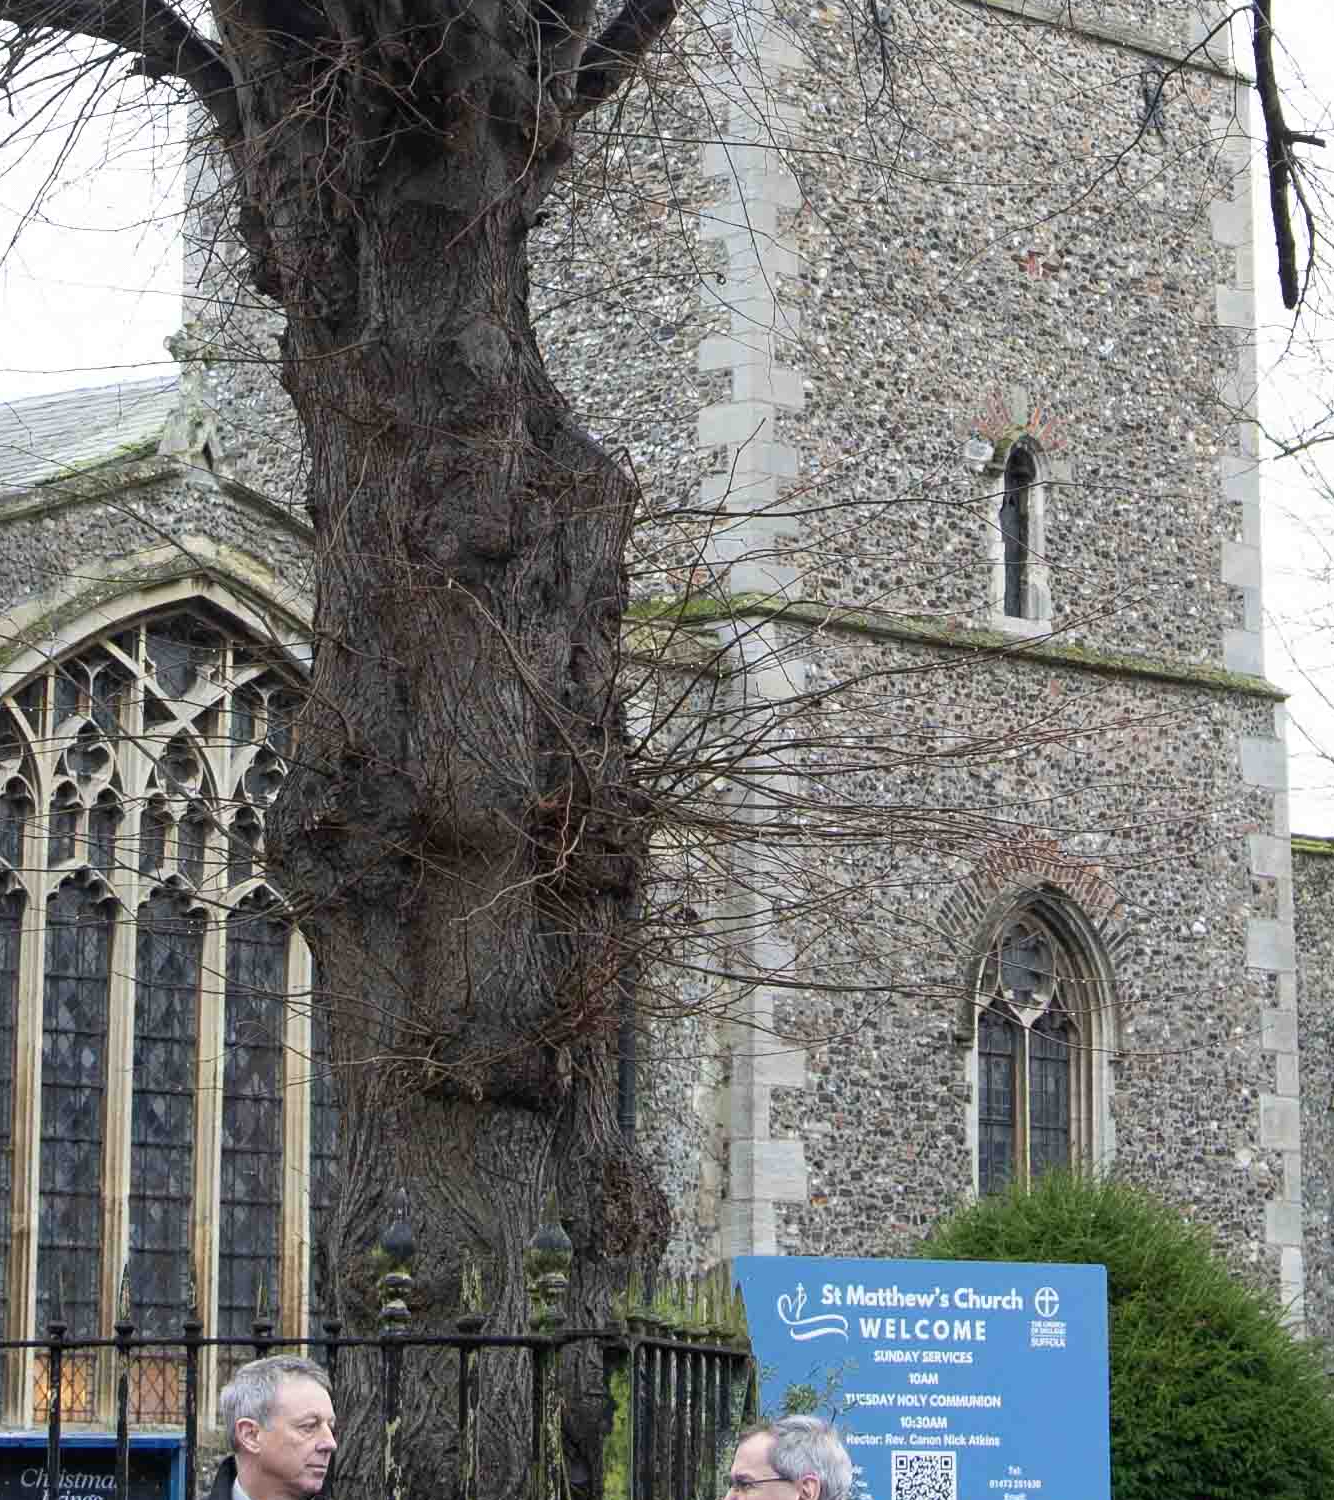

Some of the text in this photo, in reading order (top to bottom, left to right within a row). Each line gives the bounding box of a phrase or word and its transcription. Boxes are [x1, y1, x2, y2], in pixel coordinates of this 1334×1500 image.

[821, 1284, 1024, 1311] St Matthew's Church
[859, 1318, 987, 1341] WELCOME
[874, 1350, 973, 1365] SUNDAY SERVICES
[908, 1373, 939, 1386] 10AM
[844, 1393, 1002, 1409] TUESDAY HOLY COMMUNION
[900, 1416, 948, 1430] 10:30AM
[885, 1433, 907, 1447] Rev.
[909, 1434, 942, 1447] Canon
[944, 1434, 966, 1448] Nick
[968, 1435, 1000, 1448] Atkins
[21, 1468, 116, 1490] Chistma
